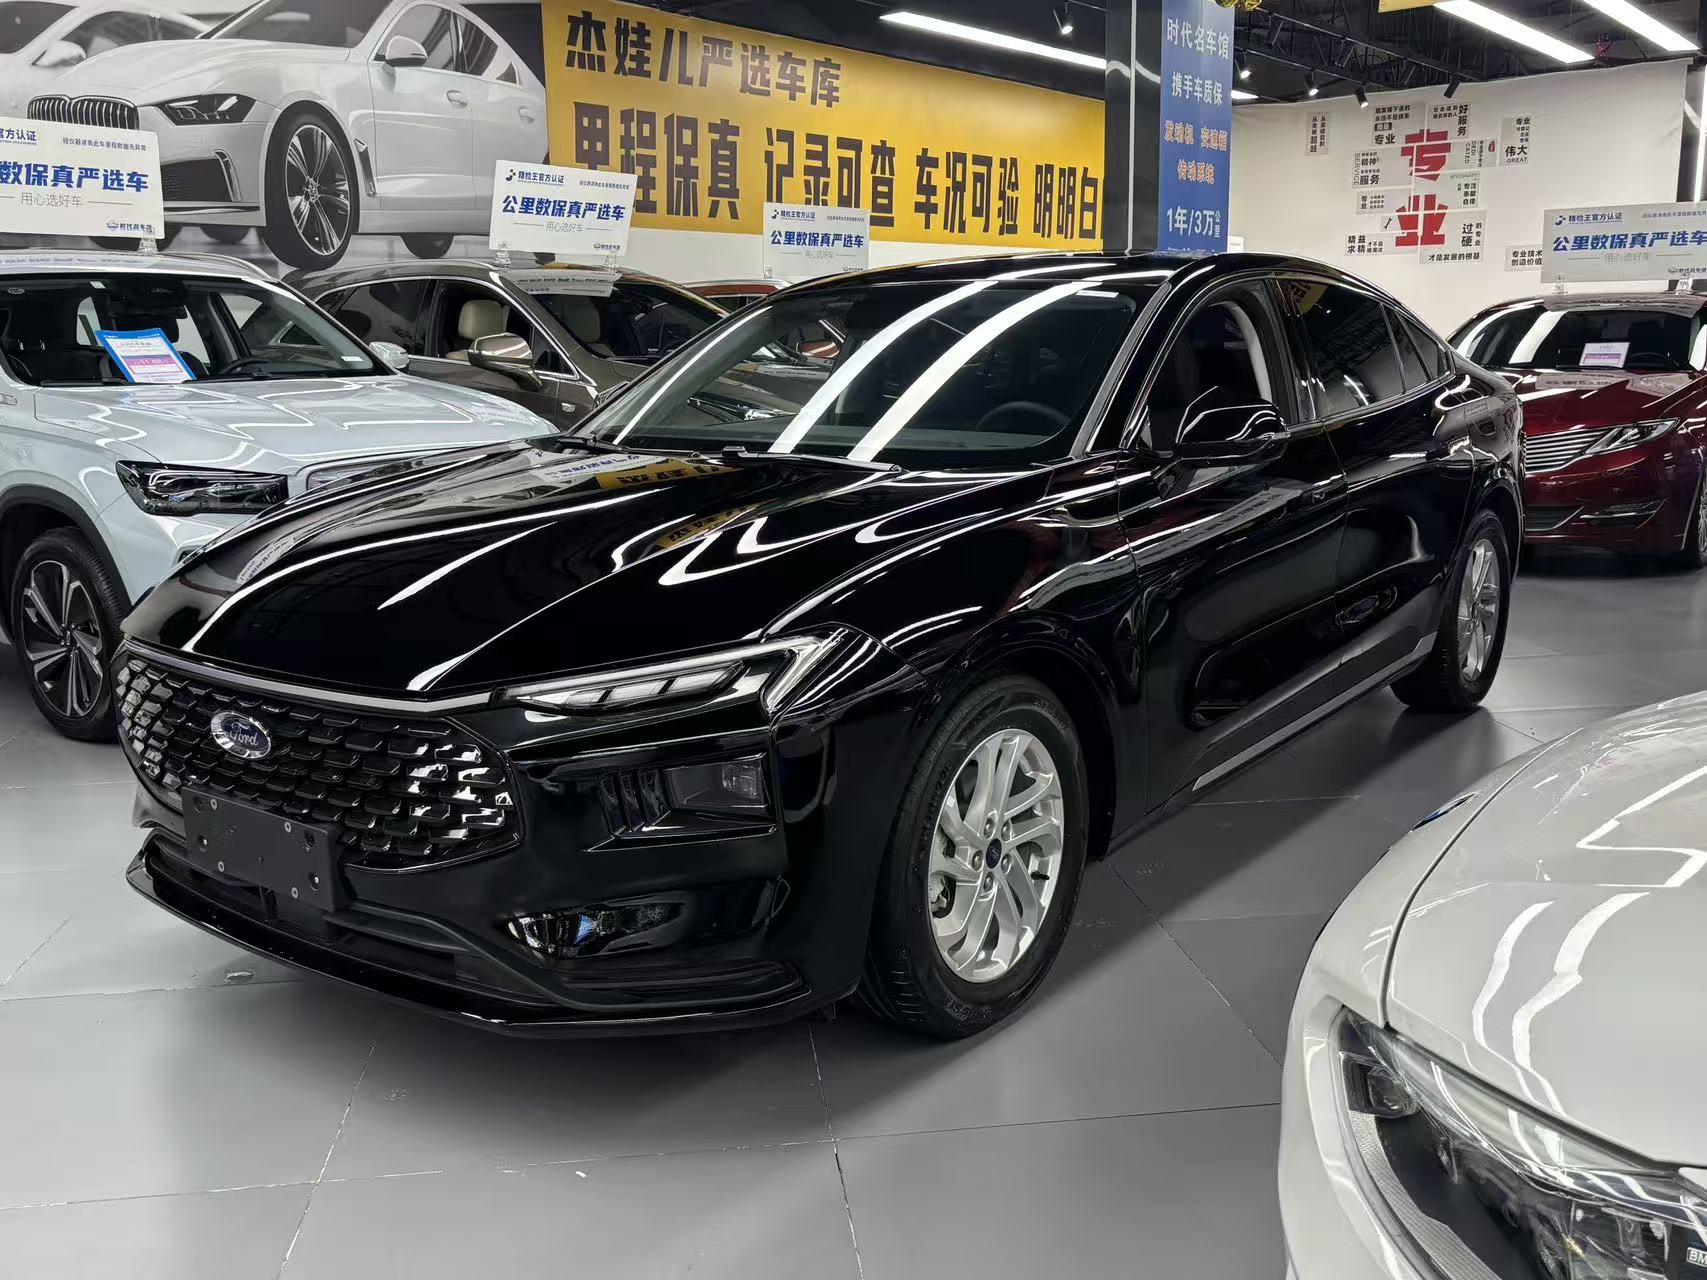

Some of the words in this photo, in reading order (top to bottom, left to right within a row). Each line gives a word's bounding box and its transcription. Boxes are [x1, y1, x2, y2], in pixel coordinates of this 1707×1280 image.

[1166, 18, 1229, 59] 时代名车馆
[566, 10, 841, 109] 杰娃儿严选车库
[1171, 71, 1223, 105] 携手车质保
[1457, 104, 1468, 137] 好服务
[1164, 119, 1194, 146] 发动机
[1200, 126, 1228, 152] 变速箱
[1374, 133, 1396, 145] 专业
[1505, 145, 1527, 157] 伟大
[518, 170, 564, 184] 精检王官方认证
[1177, 158, 1215, 185] 传动系统
[1353, 152, 1361, 187] SERVICE
[1359, 174, 1380, 186] 服务
[764, 127, 896, 227] 记录可查
[914, 147, 1020, 236] 车况可验
[1033, 163, 1099, 240] 明明白
[21, 191, 83, 208] 用心选好车
[502, 195, 626, 221] 公里数保真严选车
[1167, 206, 1214, 237] 1年/3万
[1568, 212, 1623, 224] 精检王官方认证
[771, 230, 865, 249] 公里数保真严选车
[1461, 223, 1474, 247] 过硬
[1552, 230, 1707, 252] 公里数保真严选车
[1428, 252, 1480, 261] 才是发展的根基
[1511, 249, 1543, 258] 专业技术
[1511, 257, 1543, 266] 创造价值
[229, 721, 259, 747] Ford
